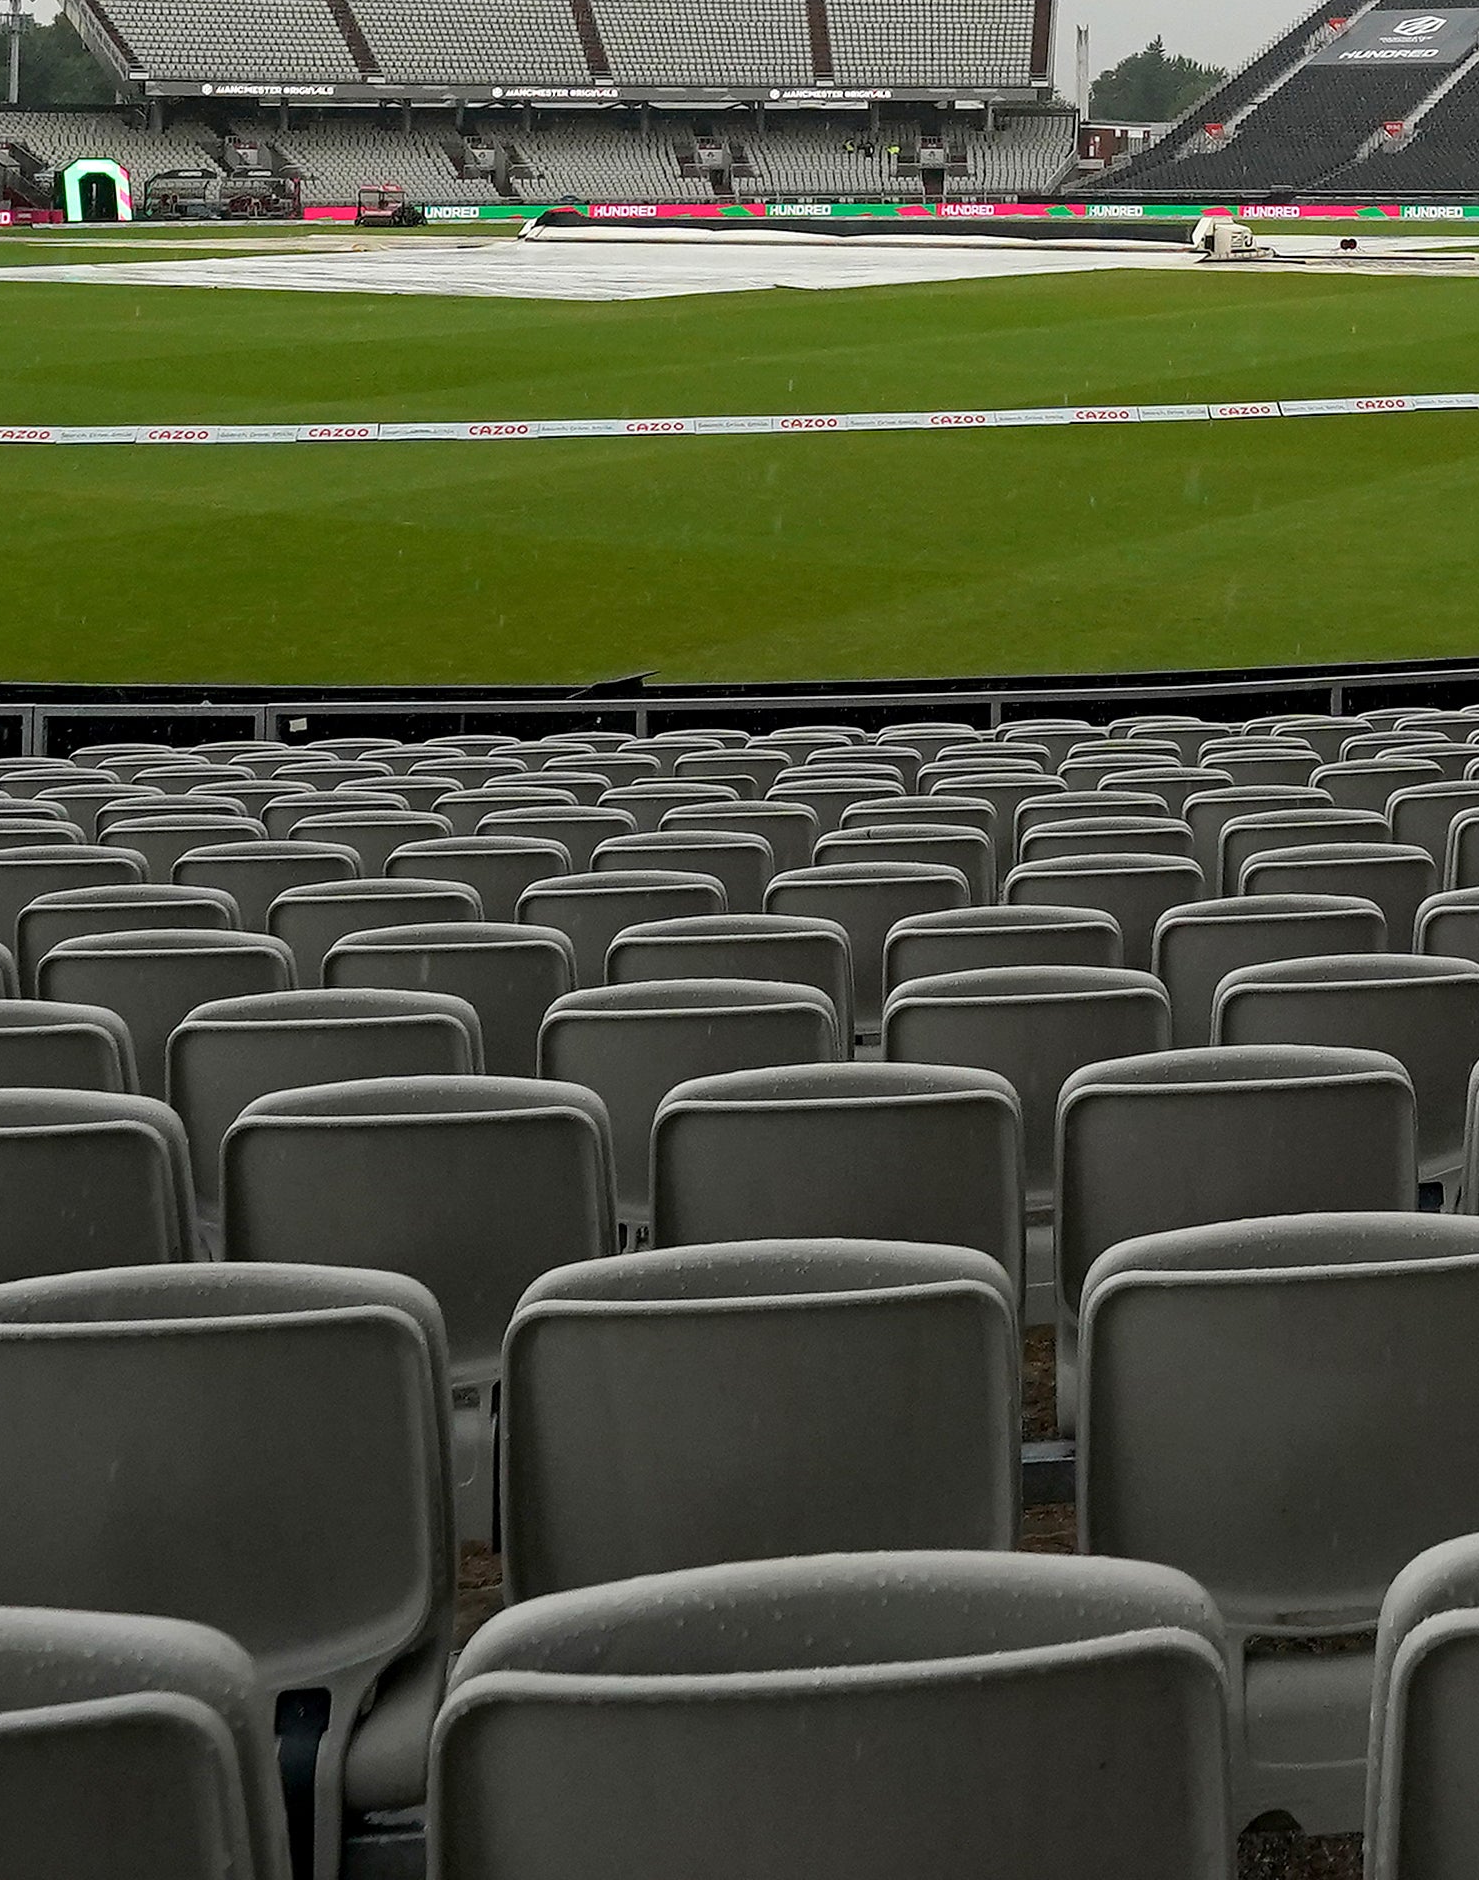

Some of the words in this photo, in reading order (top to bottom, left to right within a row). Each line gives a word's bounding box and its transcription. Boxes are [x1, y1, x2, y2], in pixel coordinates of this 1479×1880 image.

[1339, 48, 1440, 60] HUNDRED
[424, 206, 480, 218] UNDRED
[593, 205, 657, 217] HUNDRED
[769, 204, 832, 216] HUNDRED
[941, 204, 995, 215] HUNDRED
[1088, 206, 1144, 217] HUNDRED
[1242, 206, 1300, 218] HUNDRED
[1404, 206, 1464, 219] HUNDRED
[1356, 399, 1406, 409] CAZOO
[1075, 410, 1129, 420] CAZOO
[1218, 407, 1270, 417] CAZOO
[780, 418, 839, 429] CAZOO
[929, 415, 986, 425] CAZOO
[308, 427, 370, 438] CAZOO
[469, 424, 529, 436] CAZOO
[626, 422, 685, 432] CAZOO
[148, 430, 210, 441] CAZOO
